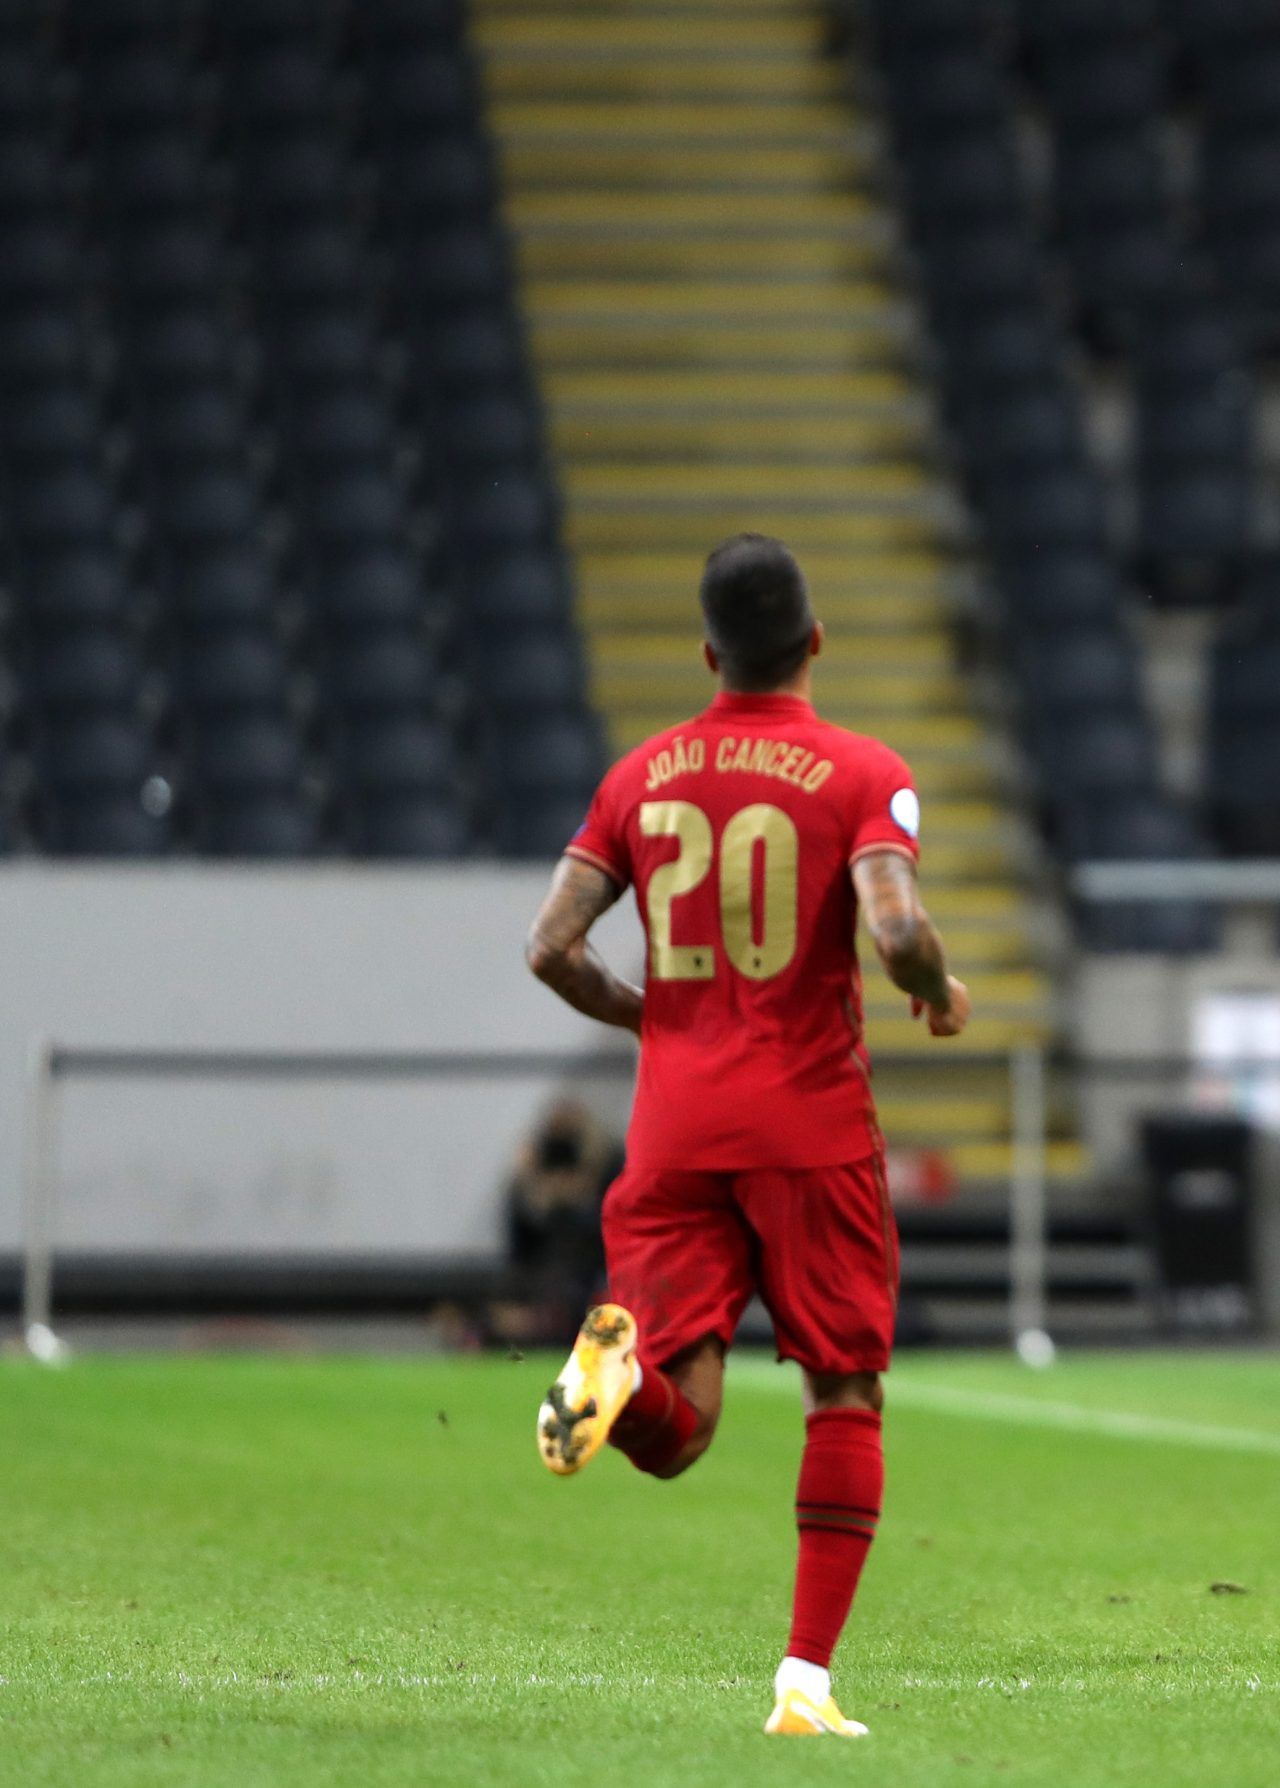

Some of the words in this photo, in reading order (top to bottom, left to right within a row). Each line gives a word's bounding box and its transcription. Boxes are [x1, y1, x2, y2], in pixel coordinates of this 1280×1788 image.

[645, 736, 705, 791] JOÃO
[715, 737, 834, 795] CANCELO
[639, 800, 799, 981] 20
